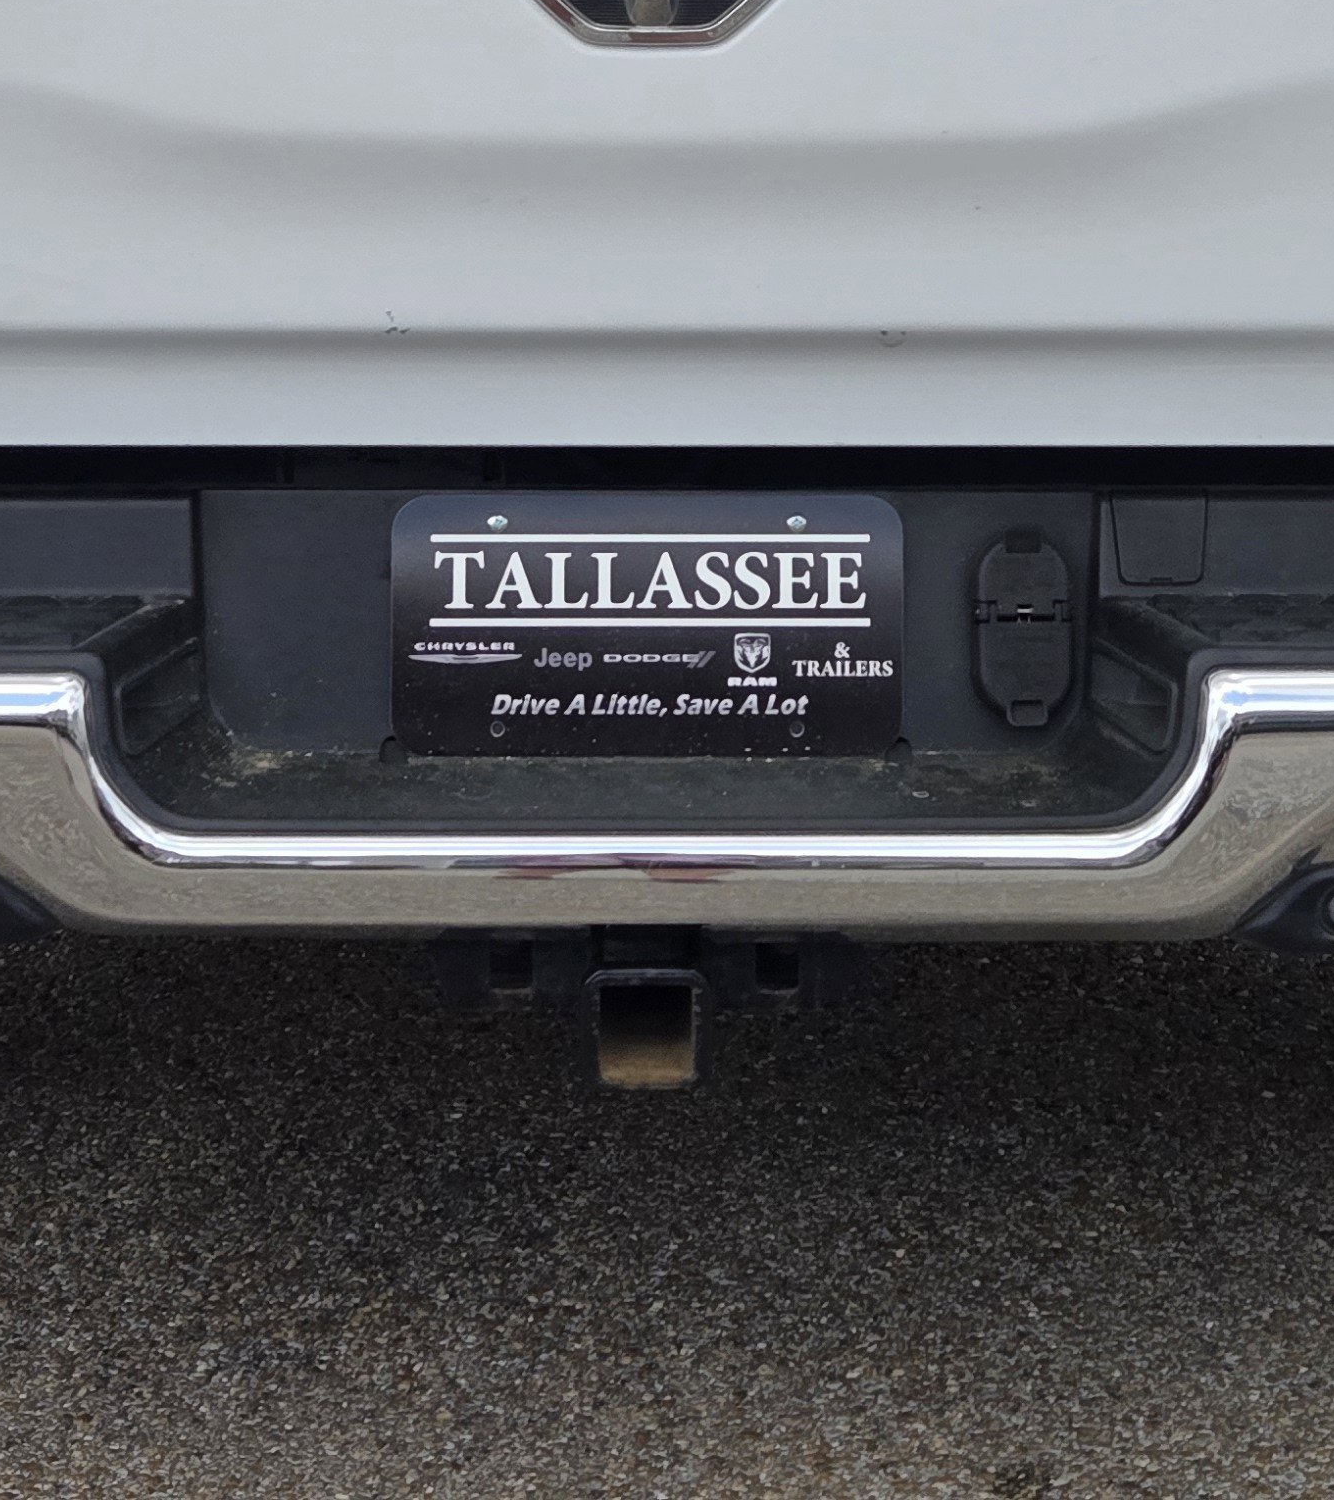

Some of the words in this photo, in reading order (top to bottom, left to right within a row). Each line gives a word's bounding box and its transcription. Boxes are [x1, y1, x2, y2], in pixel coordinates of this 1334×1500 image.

[433, 550, 867, 610] TALLASSEE
[414, 641, 515, 651] CHRYSLER
[833, 641, 851, 658] &
[534, 647, 593, 672] Jeep
[602, 653, 701, 663] DODGE
[791, 660, 894, 677] TRAILERS
[727, 676, 778, 687] RAM
[491, 693, 560, 716] Drive
[564, 693, 586, 716] A
[590, 693, 668, 718] Little,
[672, 693, 734, 716] Save
[737, 693, 760, 716] A
[764, 693, 809, 716] Lot
